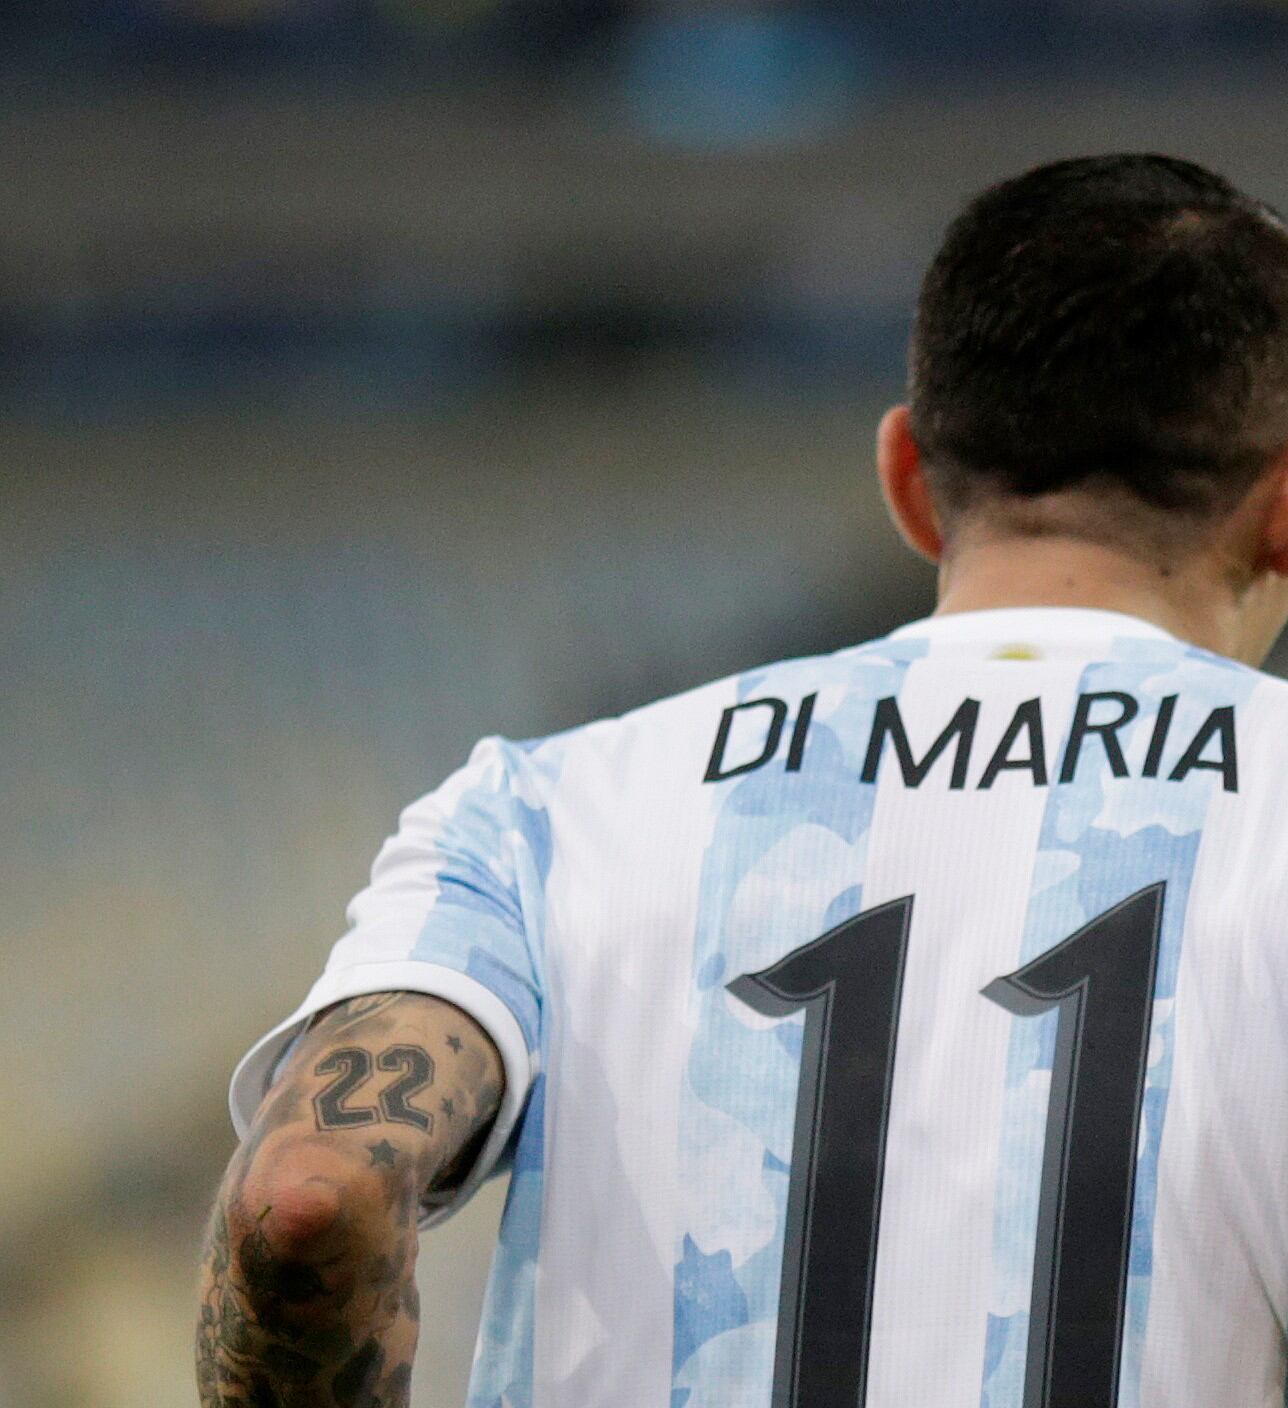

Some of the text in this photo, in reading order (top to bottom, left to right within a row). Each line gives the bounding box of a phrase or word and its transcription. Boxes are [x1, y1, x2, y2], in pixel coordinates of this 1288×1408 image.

[703, 691, 1240, 795] DI MARIA
[312, 1043, 435, 1137] 22
